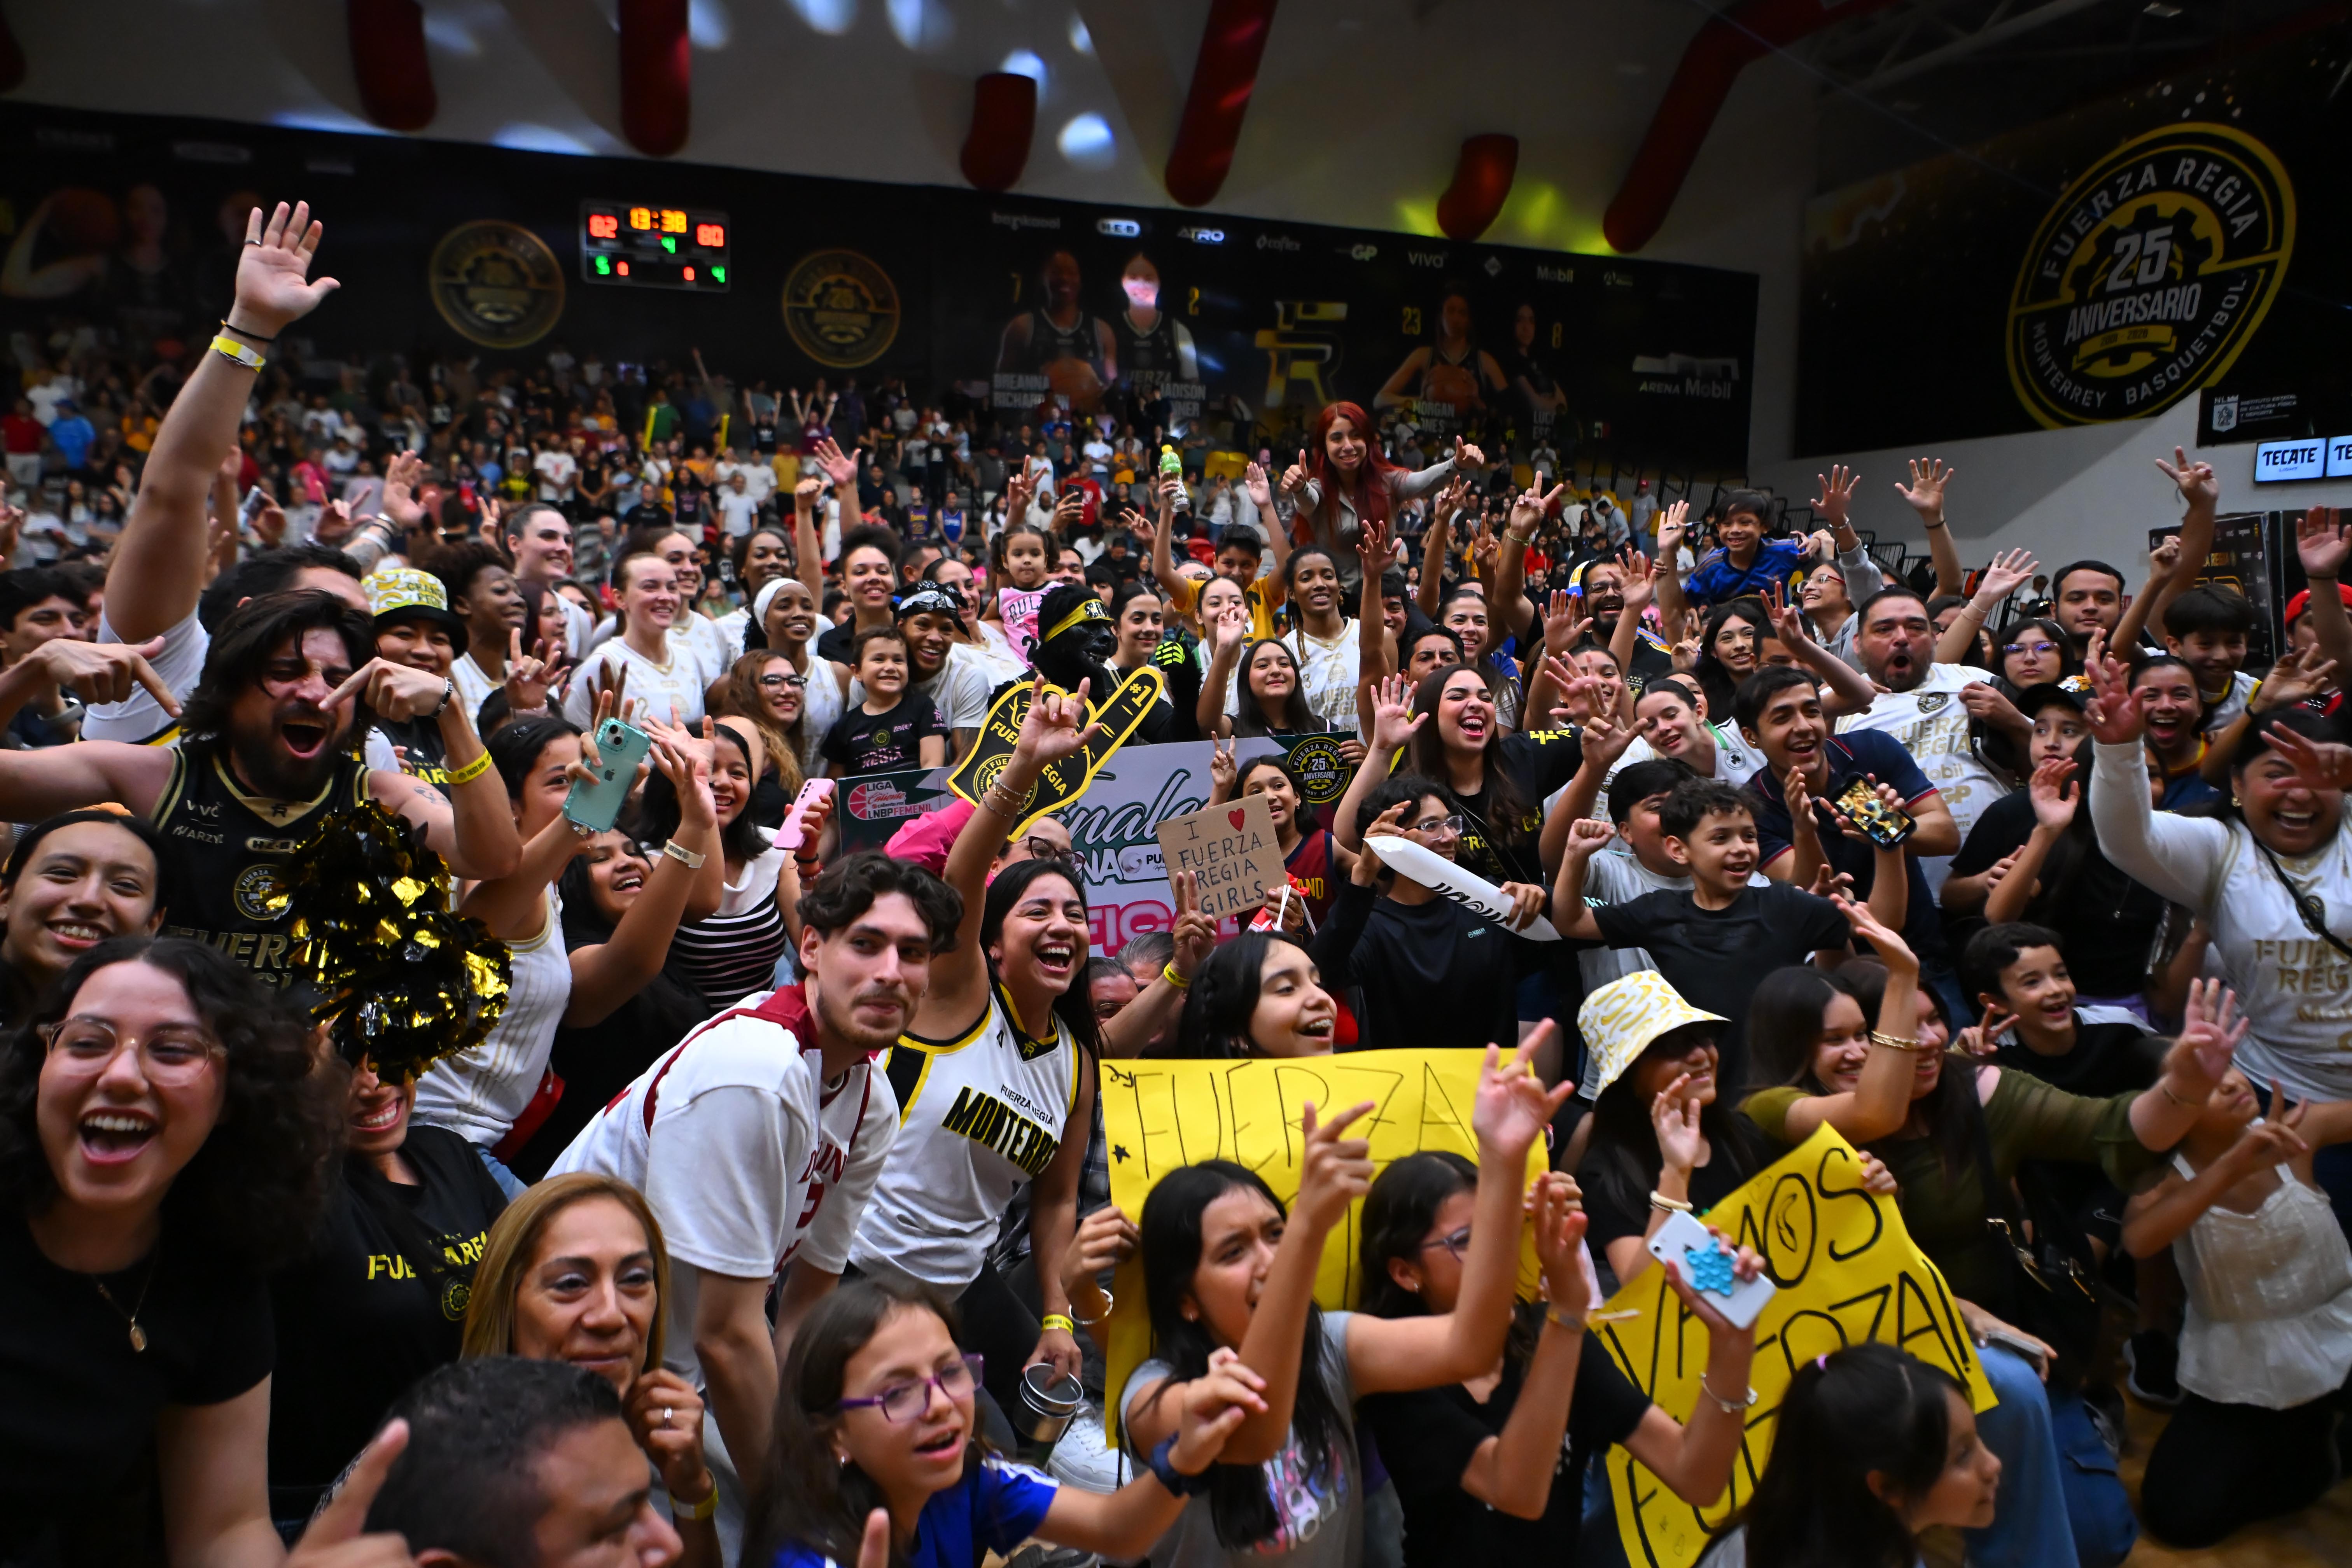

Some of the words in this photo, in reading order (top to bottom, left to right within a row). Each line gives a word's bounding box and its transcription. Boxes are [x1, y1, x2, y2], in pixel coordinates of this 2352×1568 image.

[2042, 163, 2158, 280] FUERZA
[2173, 156, 2259, 239] REGIA
[2105, 224, 2174, 294] 25
[1536, 265, 1574, 284] Mobil
[1402, 306, 1423, 336] 23
[2063, 282, 2202, 346] ANIVERSARIO
[2125, 271, 2249, 406] BASQUETBOL
[2033, 321, 2107, 410] MONTERREY
[1639, 381, 1680, 395] ARENA
[1685, 378, 1732, 400] Mobil
[2262, 447, 2318, 466] TECATE
[1129, 682, 1152, 708] #1
[1294, 743, 1320, 766] FUERZA
[1323, 744, 1343, 763] REGIA
[1312, 758, 1326, 771] 25
[866, 781, 893, 792] LIGA
[1303, 771, 1335, 781] ANIVERSARIO
[1321, 771, 1344, 796] BASQUETBOL
[867, 791, 906, 805] Caliente
[1184, 821, 1199, 840] I
[1178, 832, 1262, 868] FUERZA
[1195, 858, 1258, 890] REGIA
[1201, 880, 1264, 915] GIRLS
[1001, 1083, 1031, 1113] FUERZA
[1133, 1060, 1480, 1180] FUERZA
